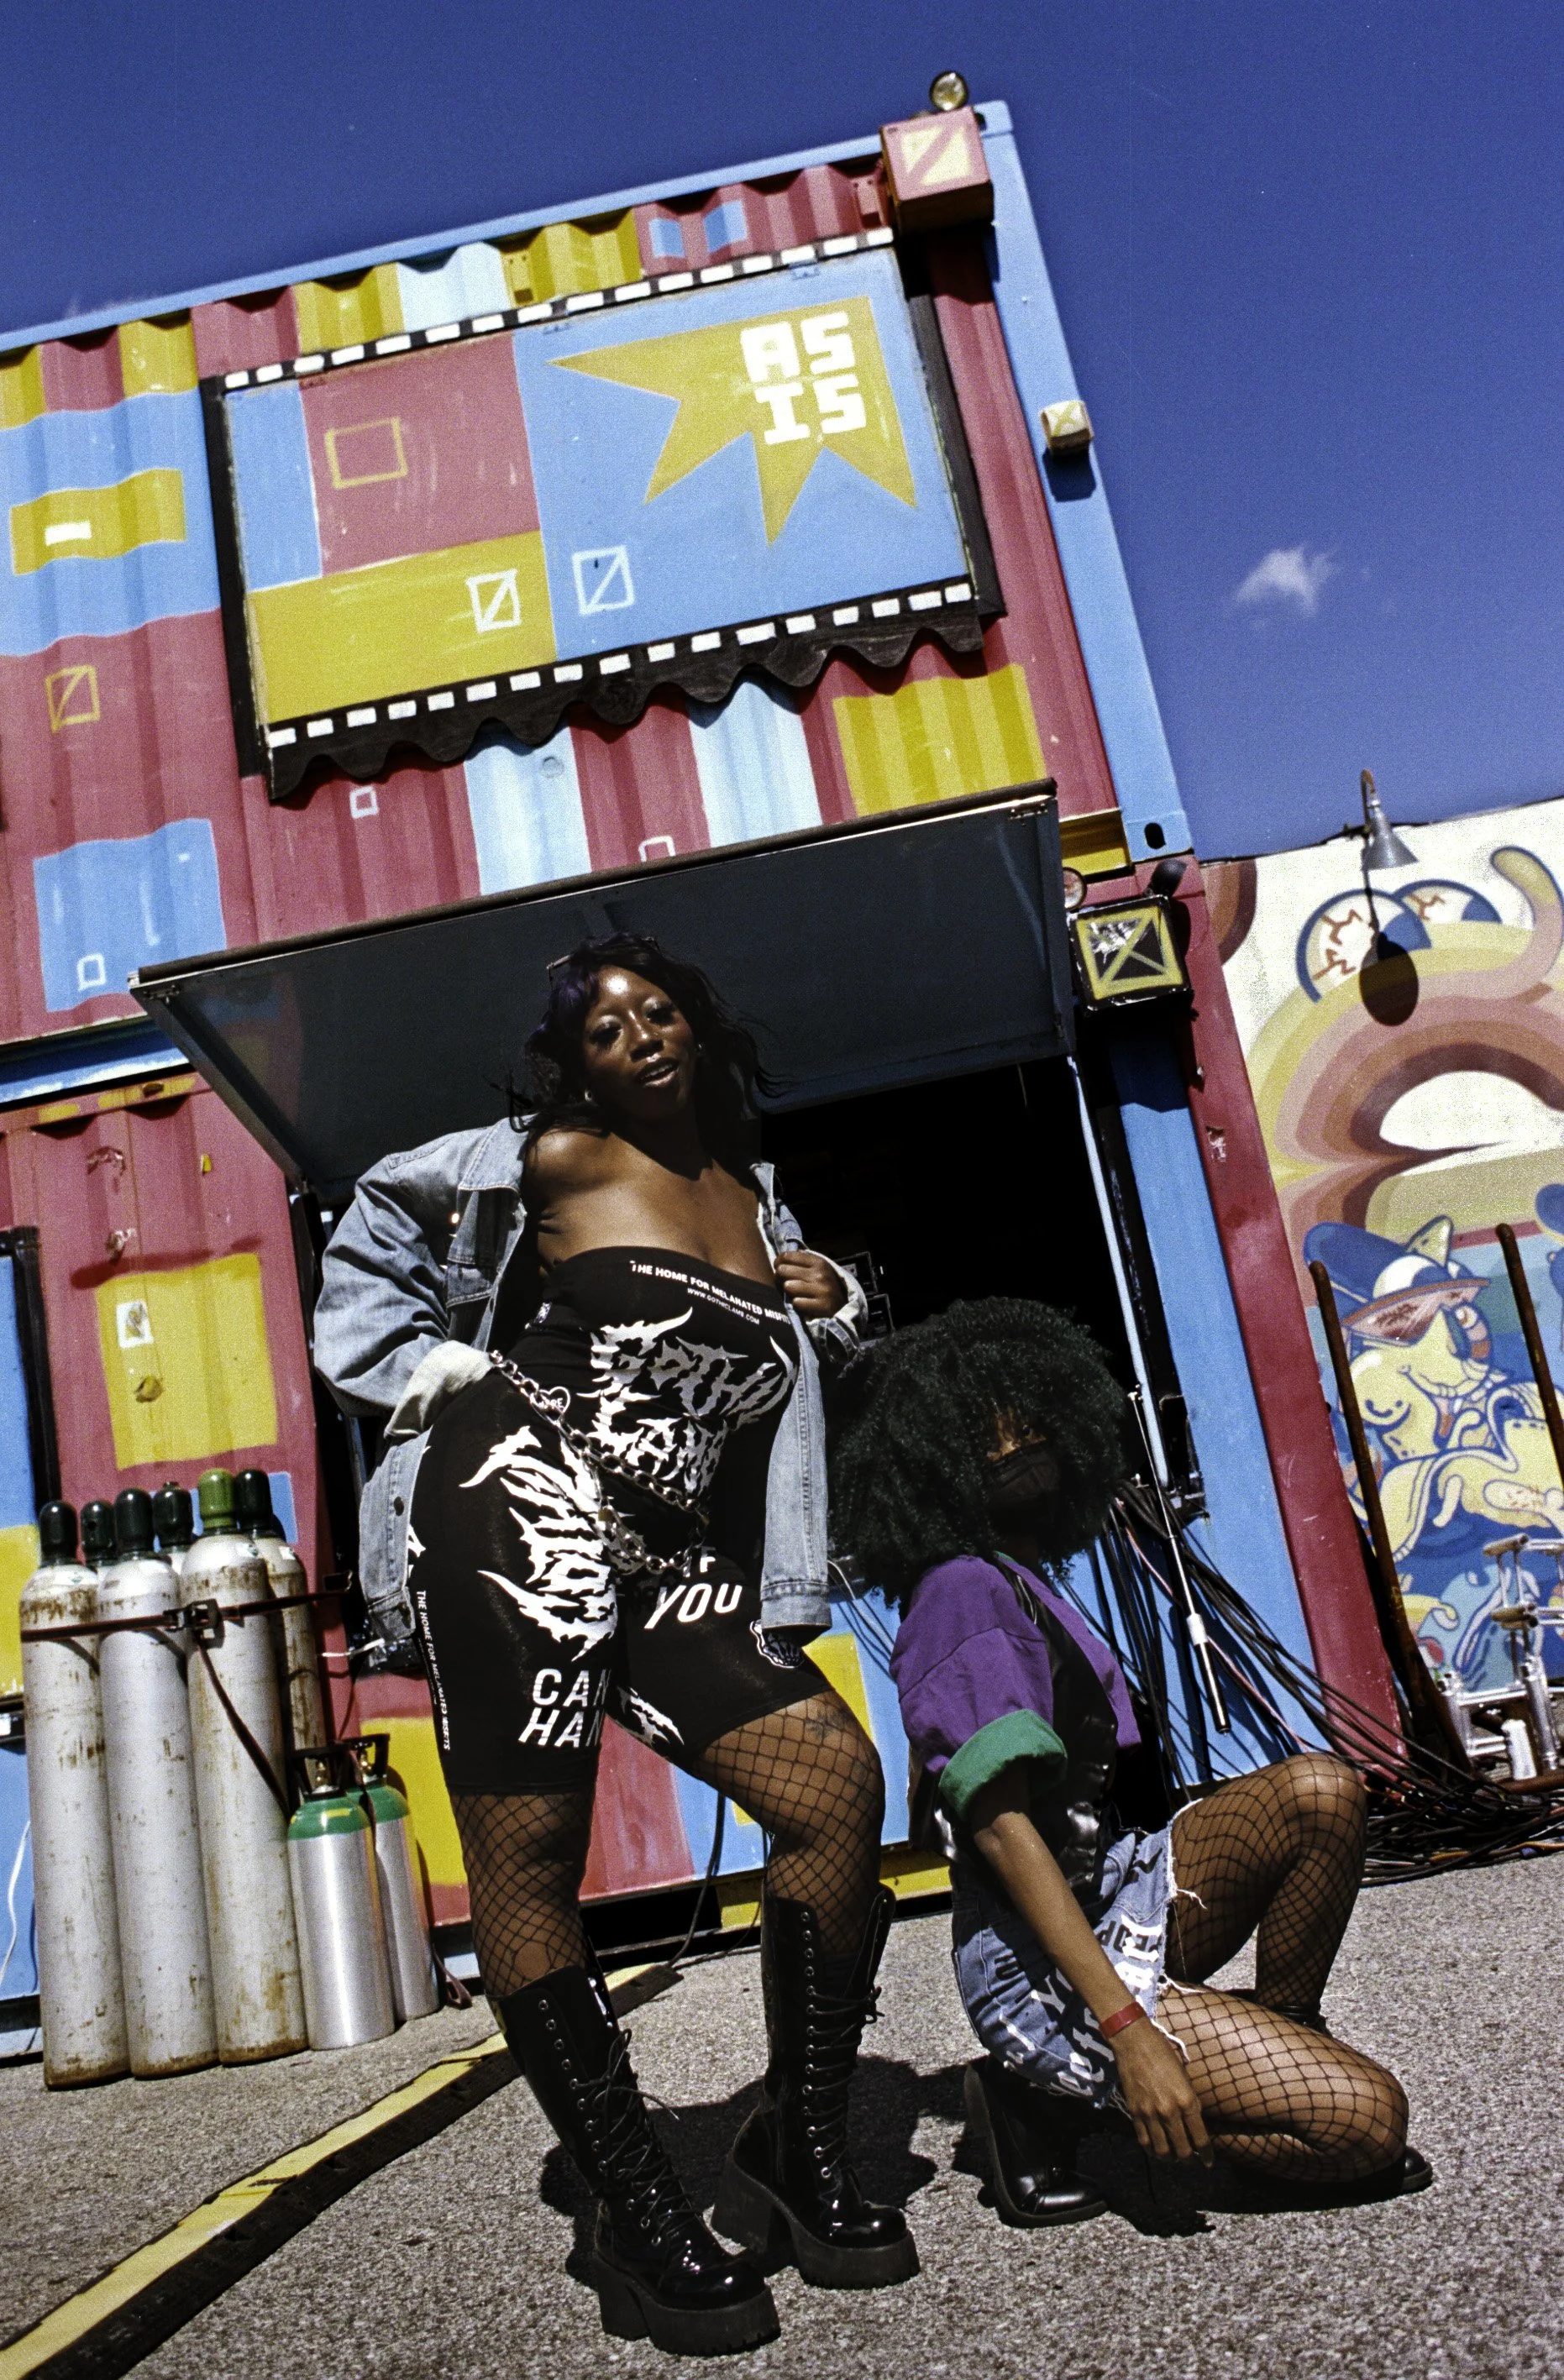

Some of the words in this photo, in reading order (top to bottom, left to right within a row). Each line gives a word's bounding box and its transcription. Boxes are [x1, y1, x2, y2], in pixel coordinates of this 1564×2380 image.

[741, 311, 855, 383] AS
[754, 374, 867, 445] IS
[630, 1261, 653, 1275] THE
[655, 1266, 688, 1283] HOME
[690, 1276, 710, 1291] FOR
[711, 1285, 763, 1315] MELANATED
[417, 1590, 427, 1610] THE
[643, 1583, 743, 1630] YOU
[420, 1612, 433, 1641] HOME
[427, 1643, 436, 1660] FOR
[532, 1668, 611, 1707] CAN
